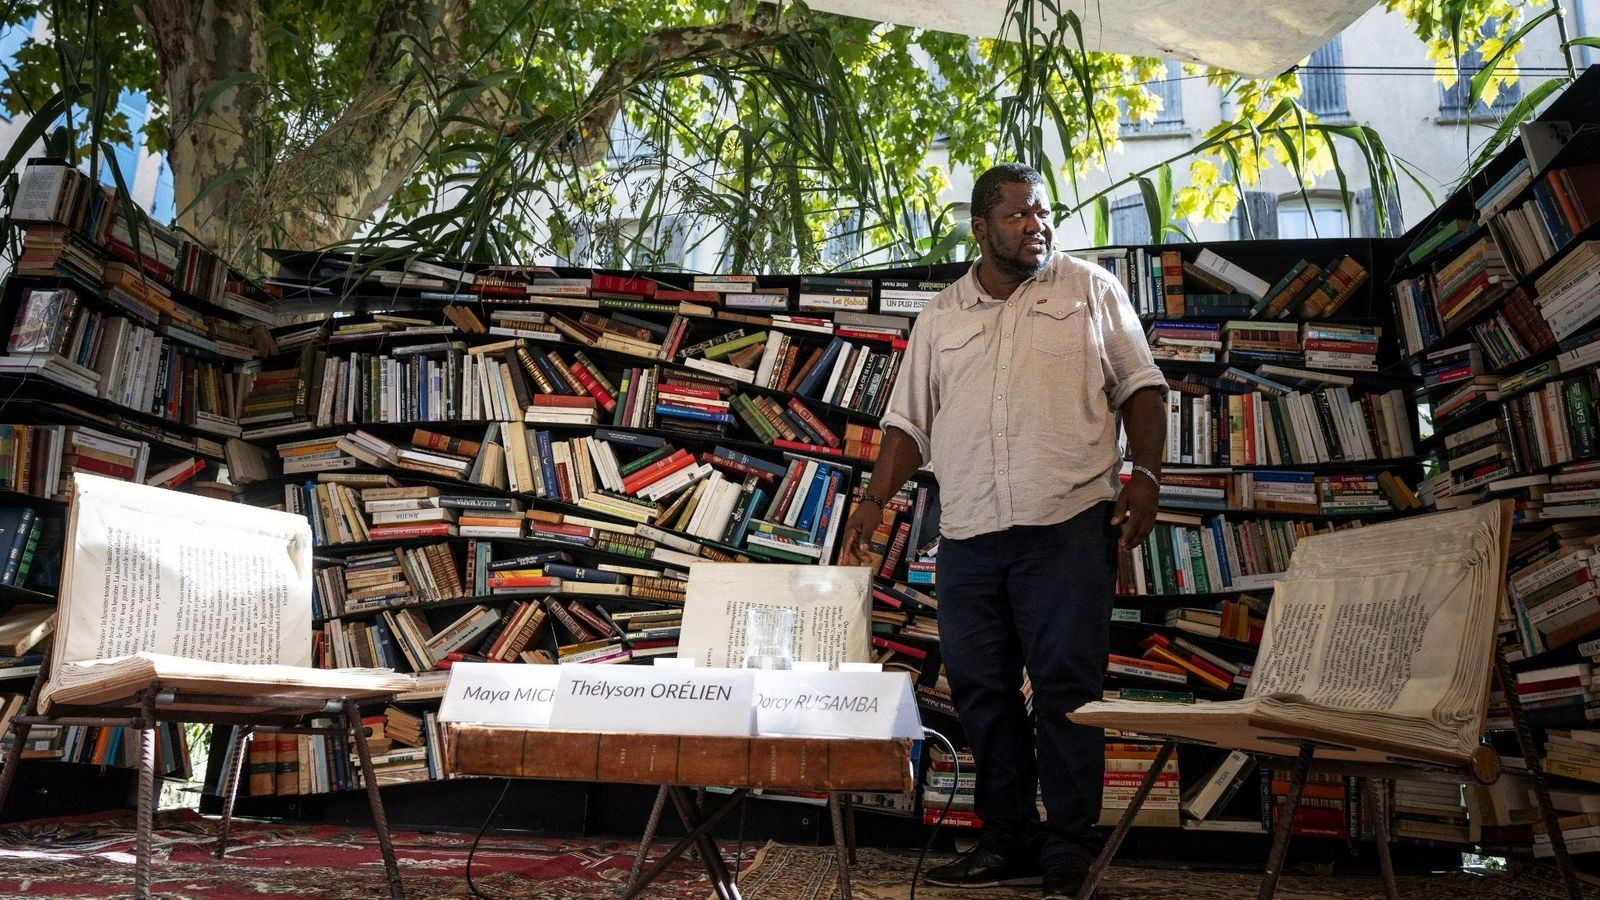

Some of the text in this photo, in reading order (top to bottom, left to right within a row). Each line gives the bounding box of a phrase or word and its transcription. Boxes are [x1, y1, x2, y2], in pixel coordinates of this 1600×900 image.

[897, 300, 912, 308] PUR
[463, 686, 510, 704] Maya
[570, 680, 732, 701] Thélyson ORÉLIEN
[794, 694, 878, 713] RUGAMBA
